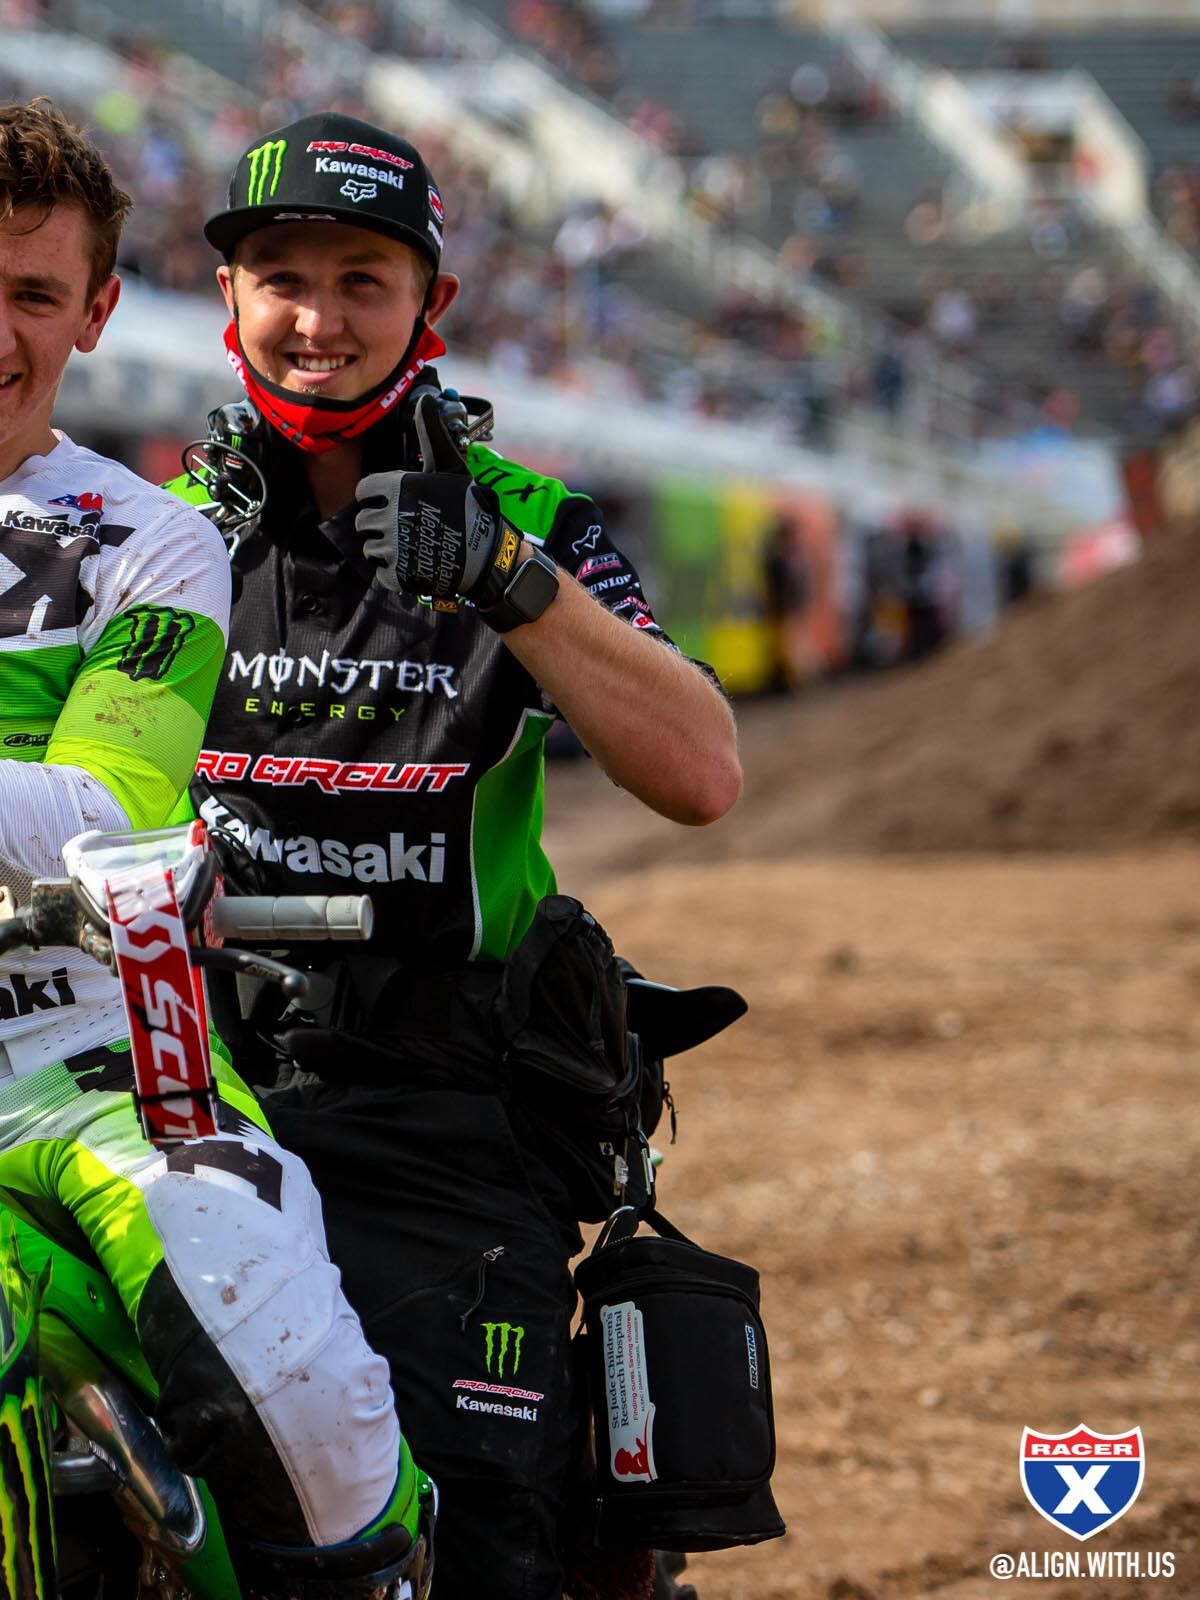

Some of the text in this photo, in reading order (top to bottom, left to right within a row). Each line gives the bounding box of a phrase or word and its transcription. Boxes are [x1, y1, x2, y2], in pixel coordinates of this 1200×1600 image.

[306, 141, 414, 170] PRO CIRCUIT
[315, 157, 404, 190] Kawasaki
[2, 510, 100, 539] Kawasa
[414, 501, 442, 583] Mechanix
[228, 647, 459, 699] MONSTER
[245, 698, 406, 722] ENERGY
[194, 749, 471, 796] RO CIRCUIT
[199, 795, 446, 883] Kawasaki
[606, 1312, 620, 1429] St. Jude Children's
[614, 1310, 629, 1427] Research Hospital
[745, 1325, 758, 1389] BRAKING
[452, 1379, 544, 1401] PRO CIRCUIT
[628, 1370, 637, 1392] cures.
[456, 1394, 538, 1422] Kawasaki
[629, 1392, 639, 1421] Finding
